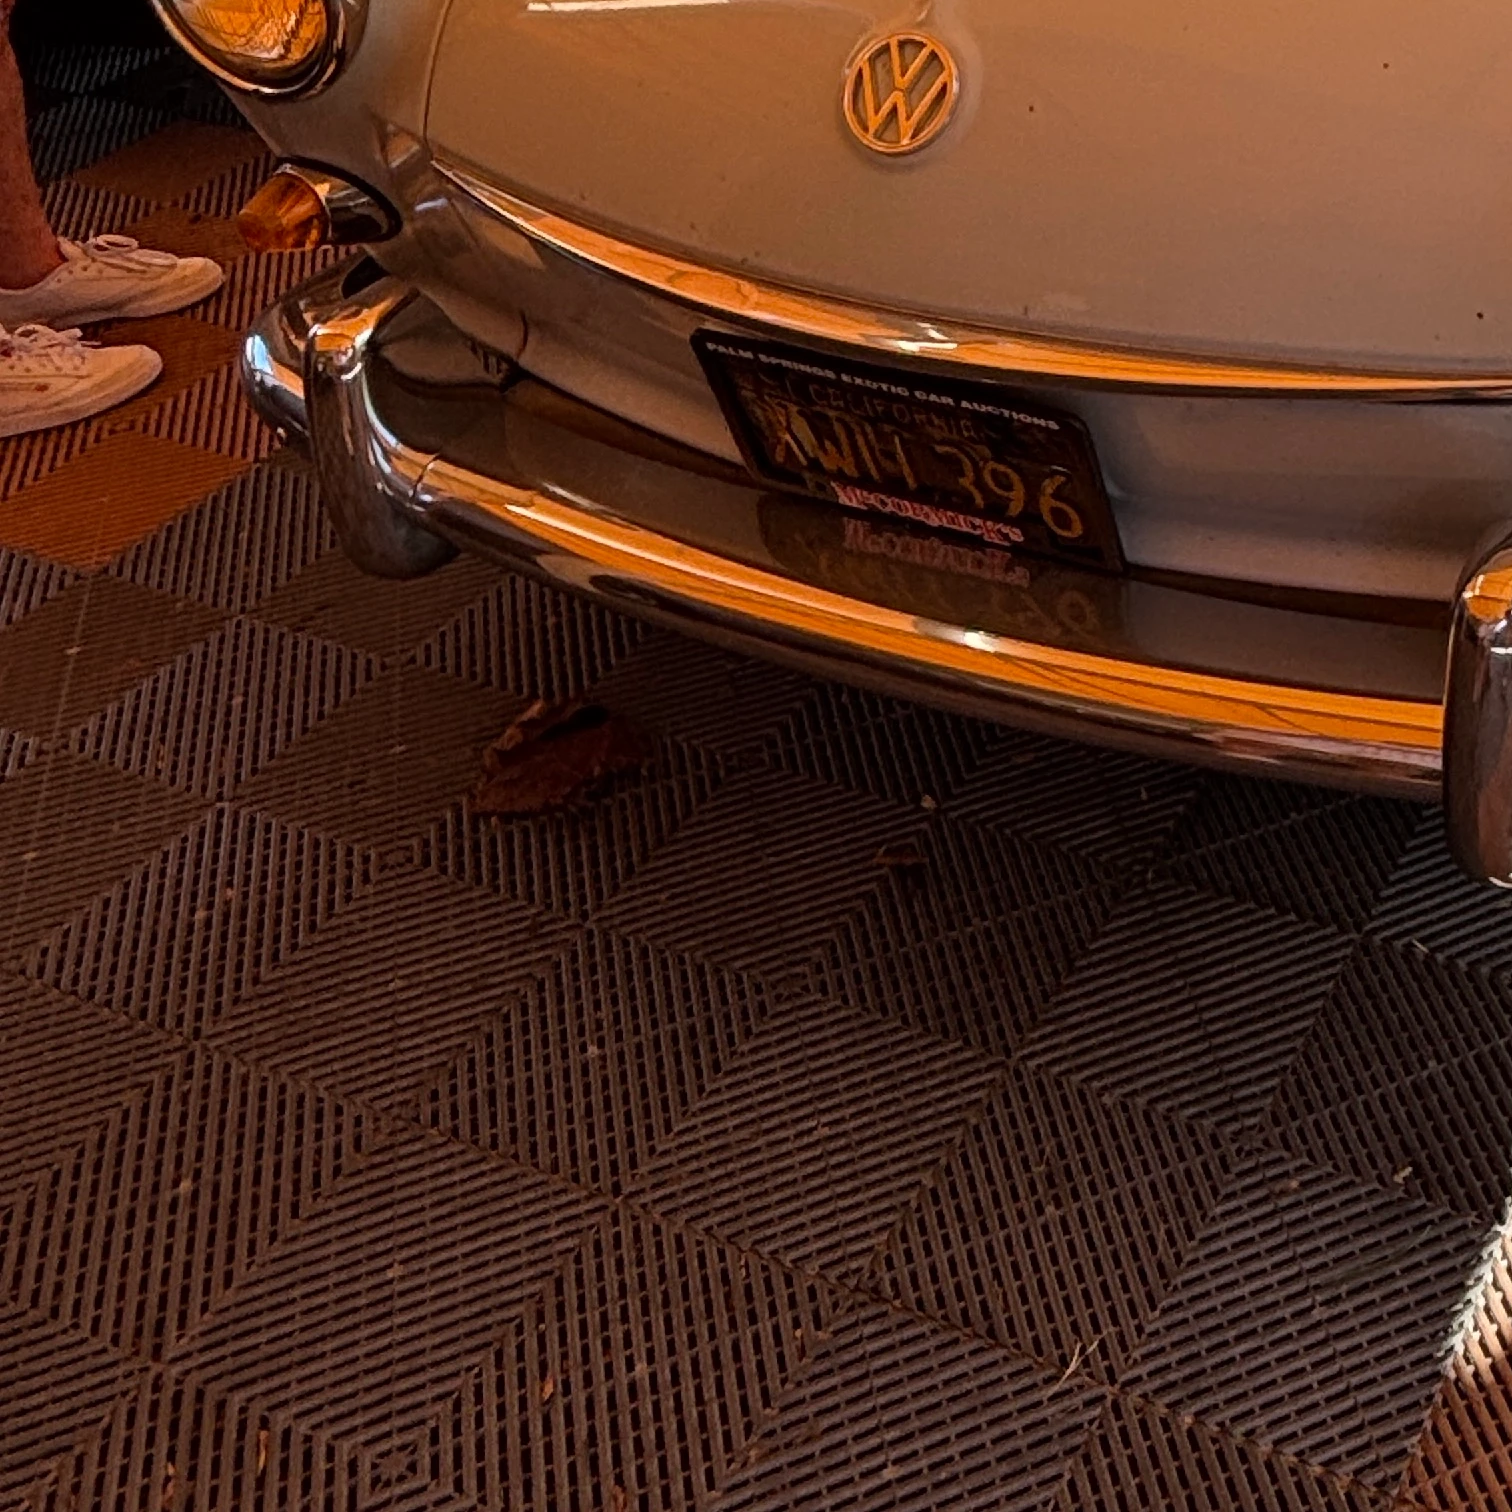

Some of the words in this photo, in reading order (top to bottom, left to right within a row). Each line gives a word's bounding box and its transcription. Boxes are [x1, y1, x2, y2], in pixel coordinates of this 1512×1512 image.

[705, 342, 754, 360] PALM
[758, 353, 837, 379] SPRINGS
[840, 373, 910, 397] EXOTIC
[914, 390, 955, 407] CAR
[960, 400, 1060, 430] AUCTIONS
[808, 383, 977, 440] CALIFORNIA
[931, 444, 1083, 538] 396
